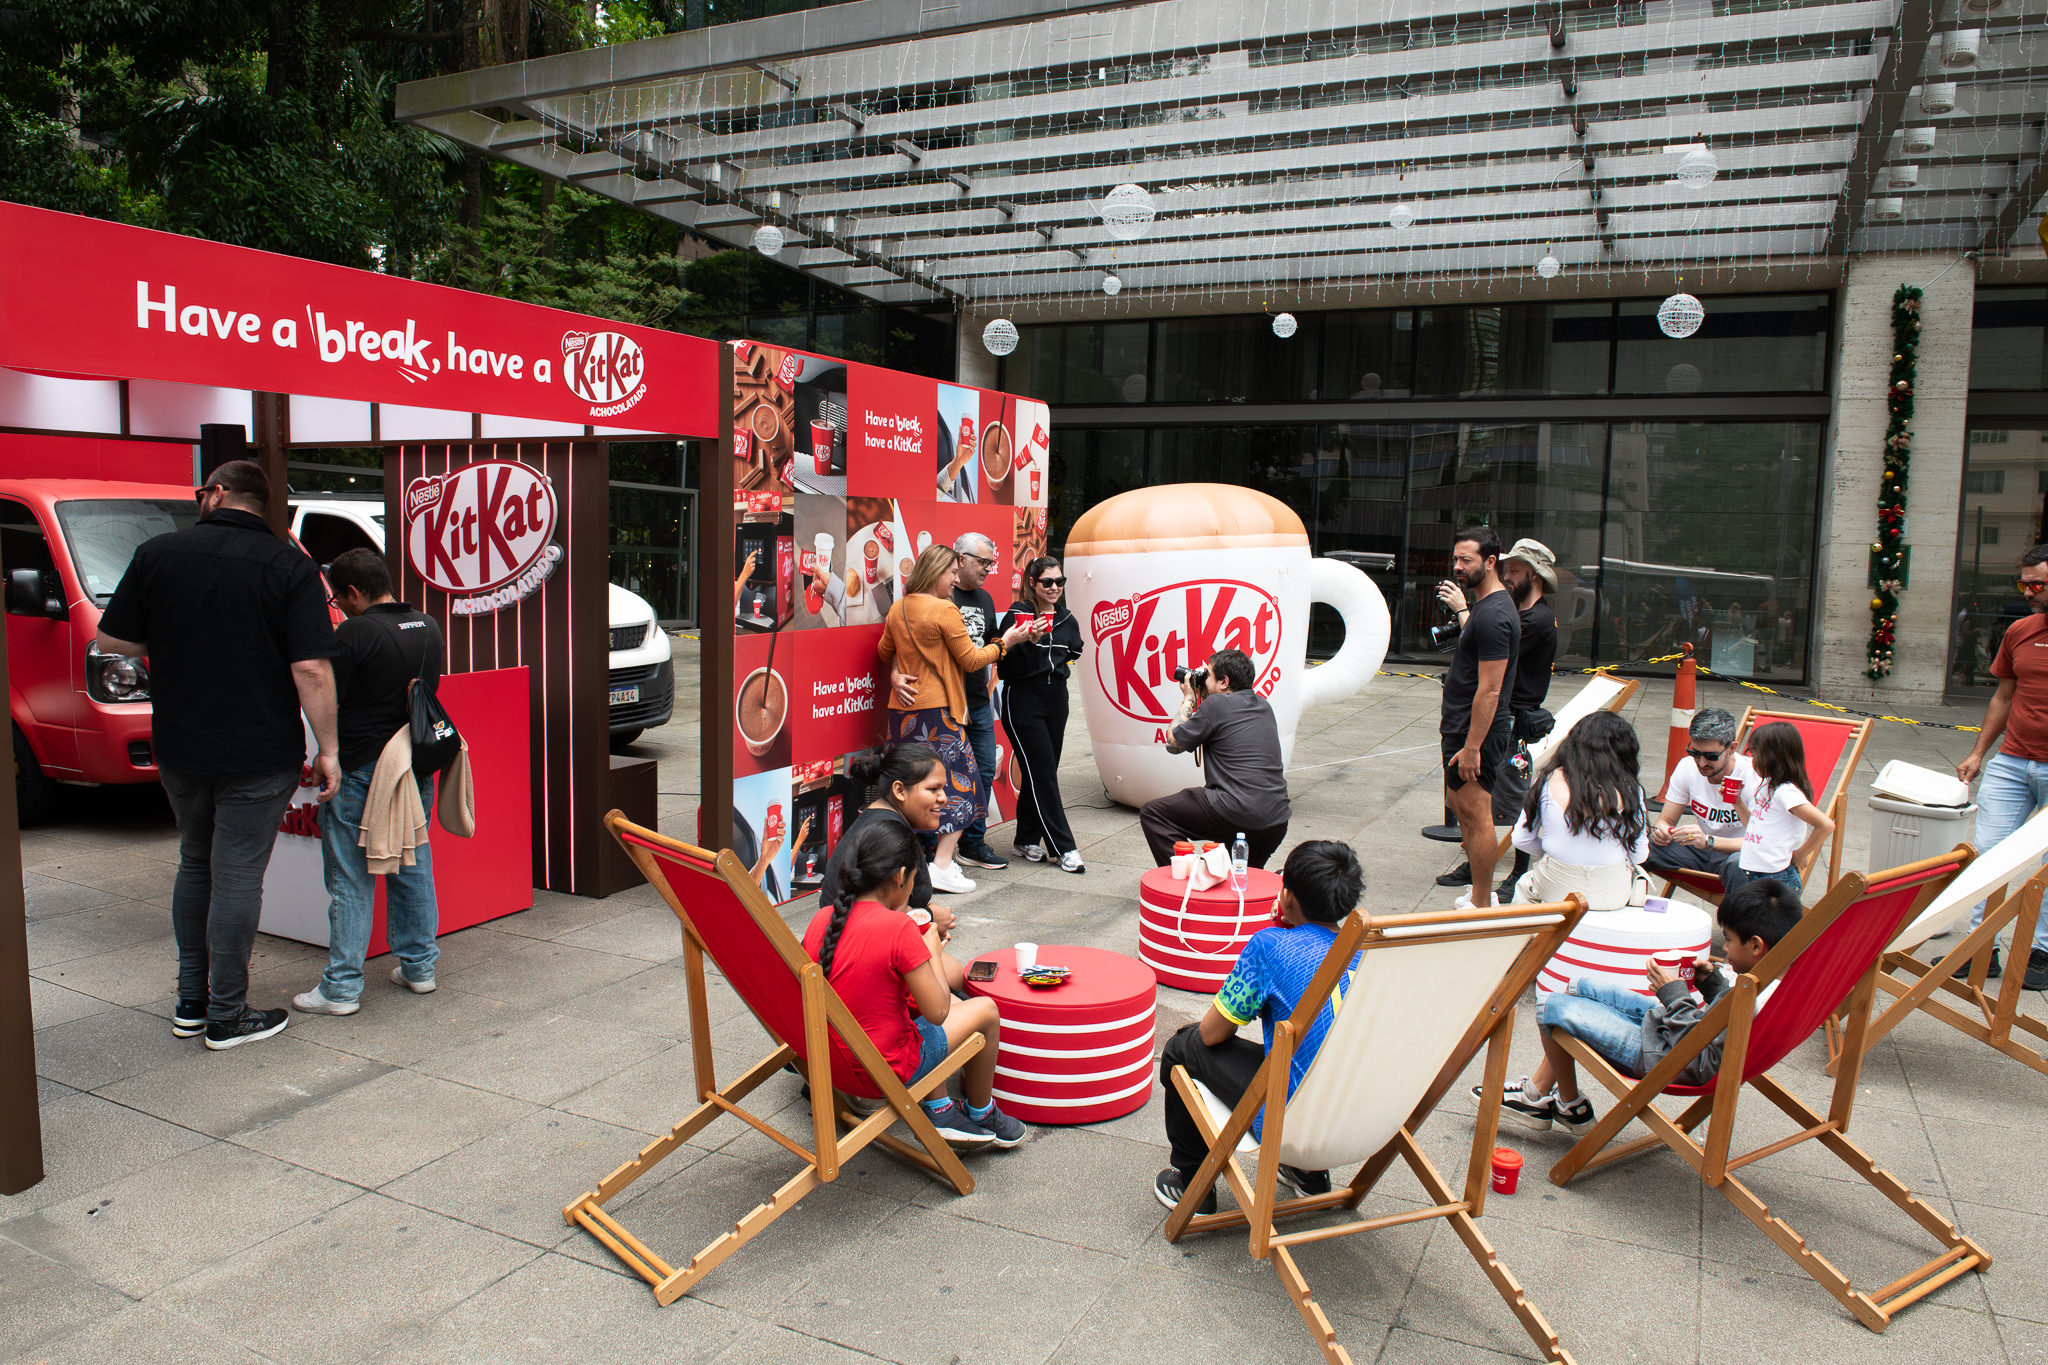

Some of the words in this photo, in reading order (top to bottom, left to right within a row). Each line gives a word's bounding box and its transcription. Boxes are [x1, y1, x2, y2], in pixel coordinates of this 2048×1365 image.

[137, 280, 261, 343] Have
[272, 318, 297, 348] a
[315, 311, 441, 375] break,
[448, 331, 524, 379] have
[533, 359, 551, 383] a
[565, 337, 584, 349] Nestlé
[574, 334, 641, 401] KitKat
[589, 383, 647, 417] ACHOCOLATADO
[865, 410, 888, 427] Have
[888, 418, 894, 428] a
[896, 415, 923, 434] break,
[865, 432, 885, 448] have
[887, 439, 893, 449] a
[894, 435, 921, 454] KitKat
[410, 483, 440, 508] Nestlé
[424, 466, 543, 588] KitKat
[452, 545, 561, 615] ACHOCOLATADO
[1094, 605, 1130, 631] Nestlé
[1111, 587, 1273, 717] KitKat
[813, 681, 837, 696] Have
[838, 682, 845, 692] a
[847, 672, 875, 694] break,
[812, 704, 835, 719] have
[836, 704, 843, 714] a
[844, 695, 874, 714] KitKat
